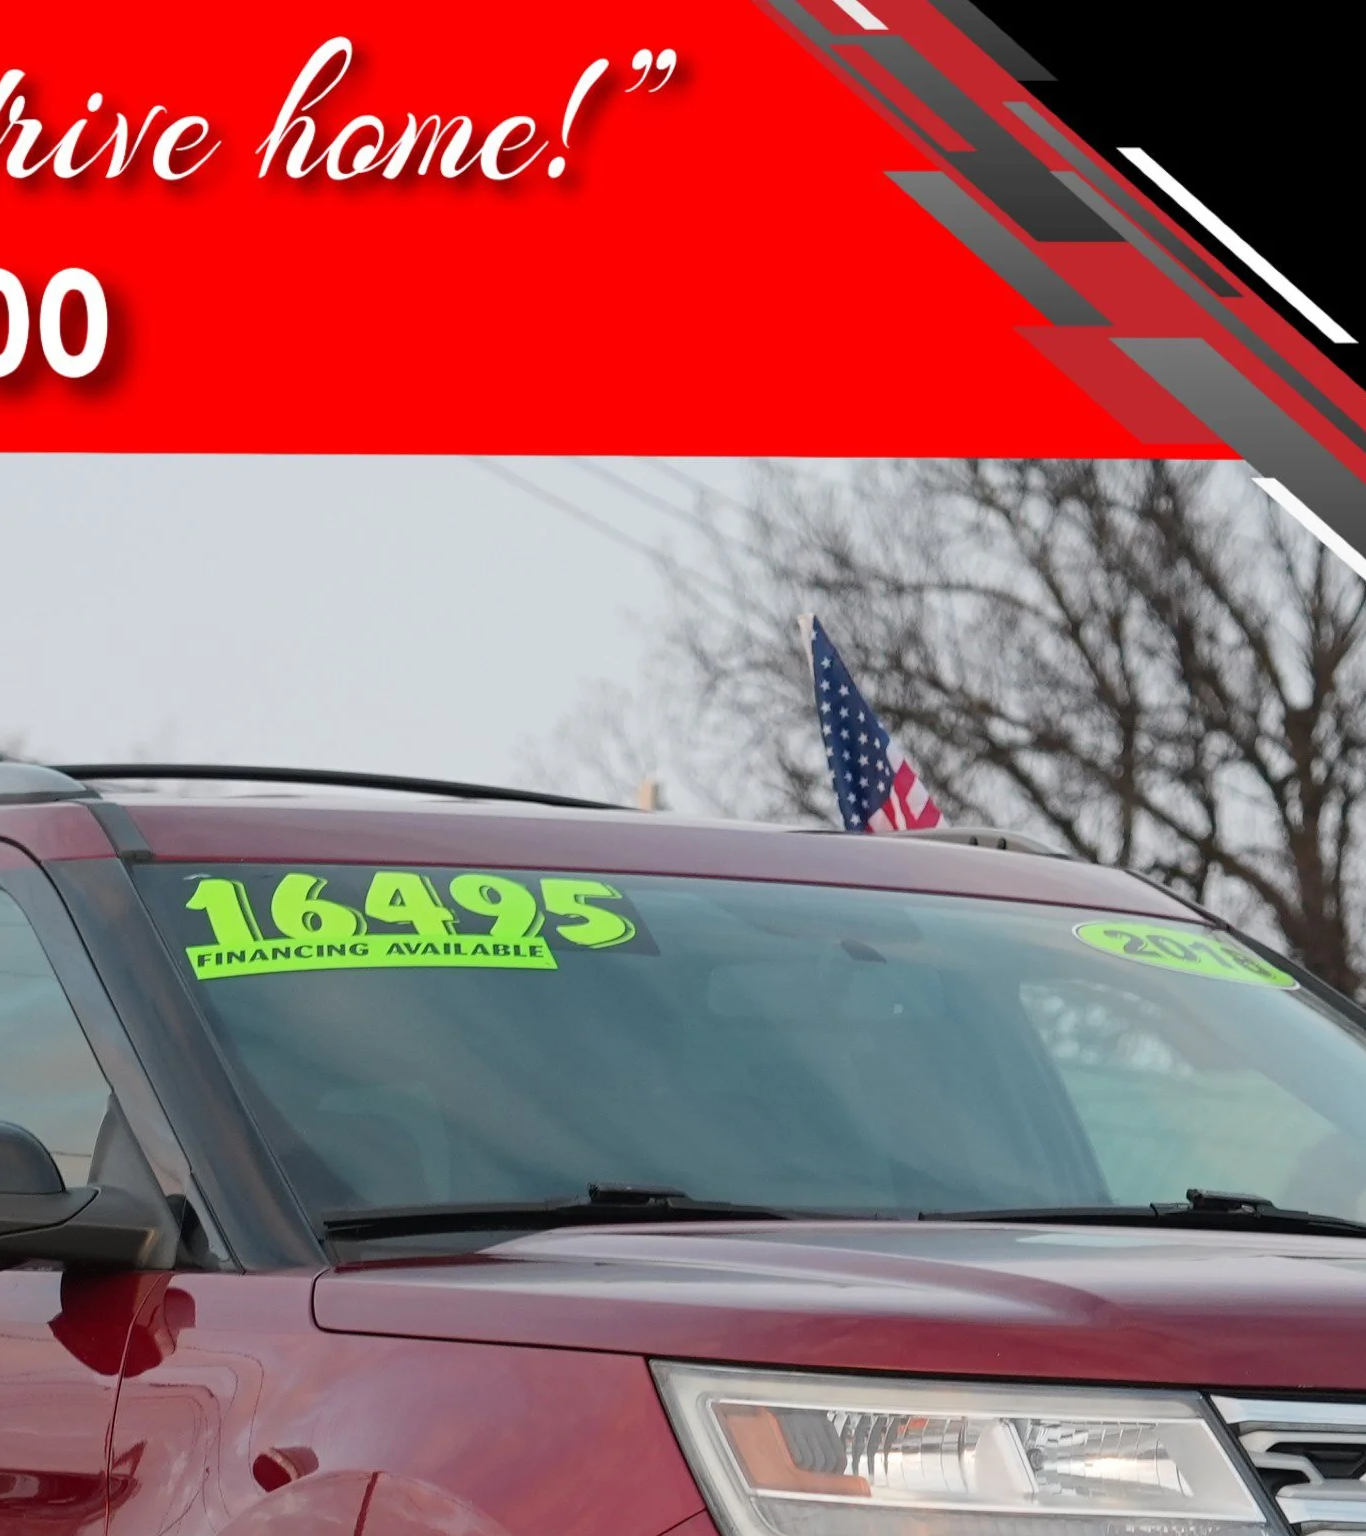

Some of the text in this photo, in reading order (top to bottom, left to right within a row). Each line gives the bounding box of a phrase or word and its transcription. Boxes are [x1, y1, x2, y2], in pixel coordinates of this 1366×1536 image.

[185, 871, 635, 949] 16495
[197, 941, 544, 967] FINANCING AVAILABLE
